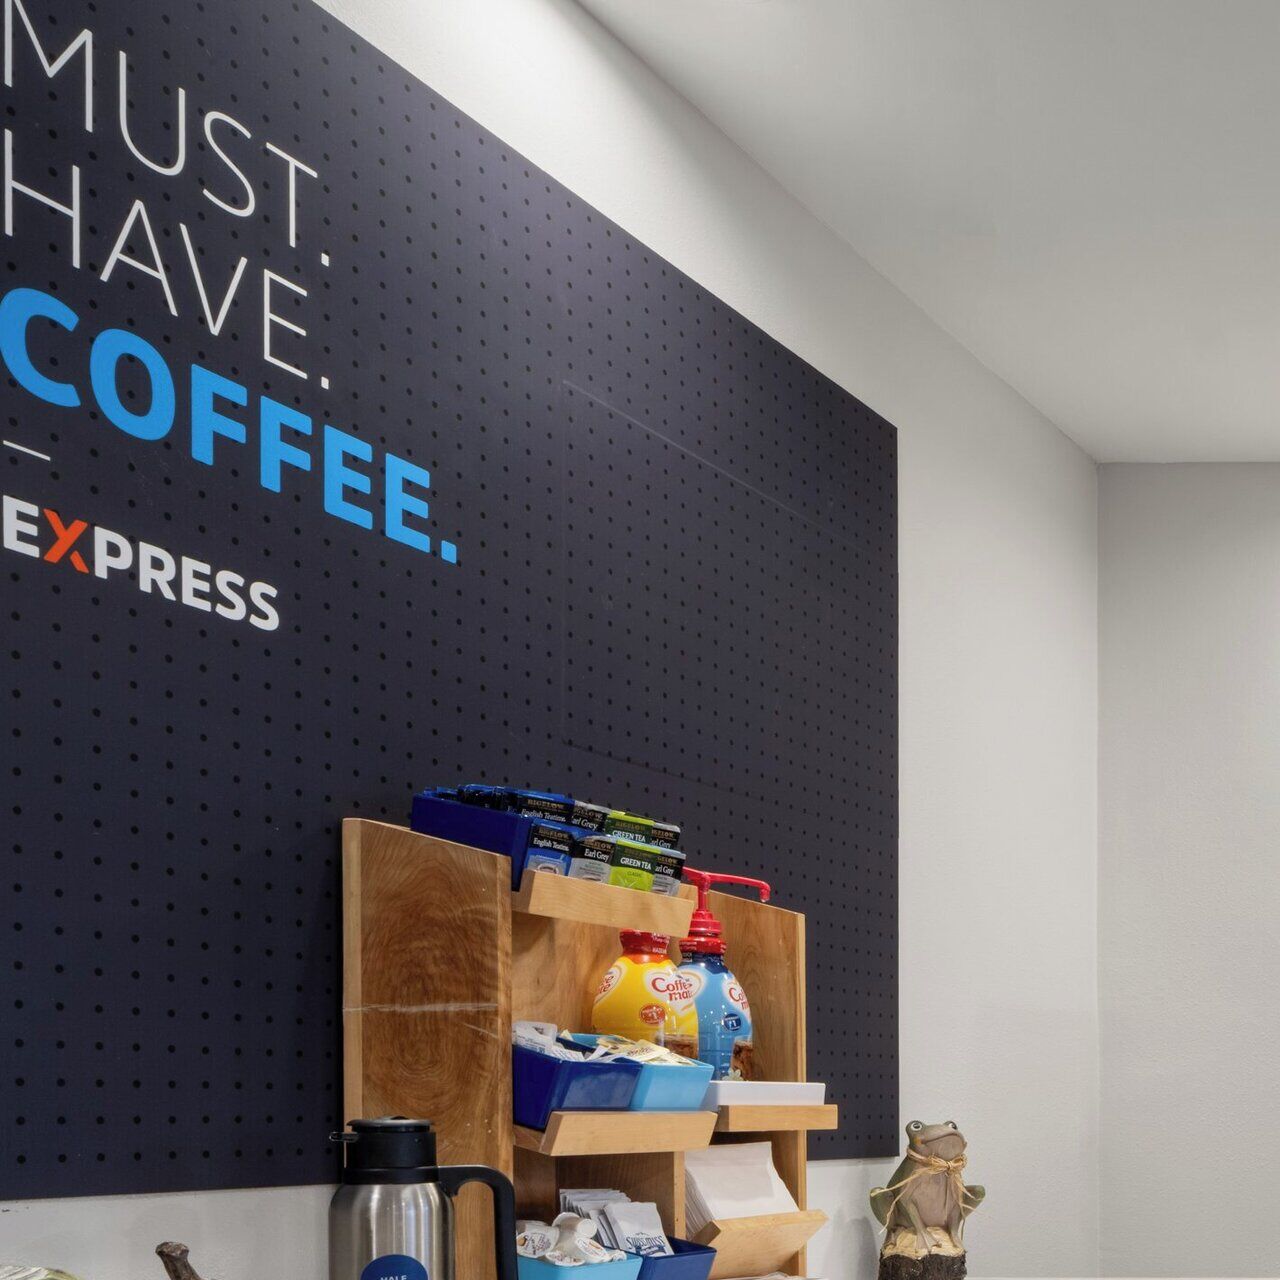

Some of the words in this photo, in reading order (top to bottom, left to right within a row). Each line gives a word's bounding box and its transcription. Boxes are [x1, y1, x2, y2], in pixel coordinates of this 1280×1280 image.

[4, 0, 330, 268] MUST.
[4, 128, 330, 390] HAVE.
[0, 287, 458, 565] COFFEE.
[2, 494, 280, 632] EXPRESS
[571, 815, 581, 825] arl
[581, 819, 599, 832] Grey
[533, 837, 553, 848] English
[612, 830, 634, 840] GREEN
[635, 833, 646, 843] TEA
[651, 838, 659, 847] arl
[584, 848, 597, 858] Earl
[596, 851, 610, 863] Grey
[620, 857, 640, 868] GREEN
[641, 861, 652, 871] TEA
[654, 864, 662, 873] arl
[662, 865, 674, 877] Grey
